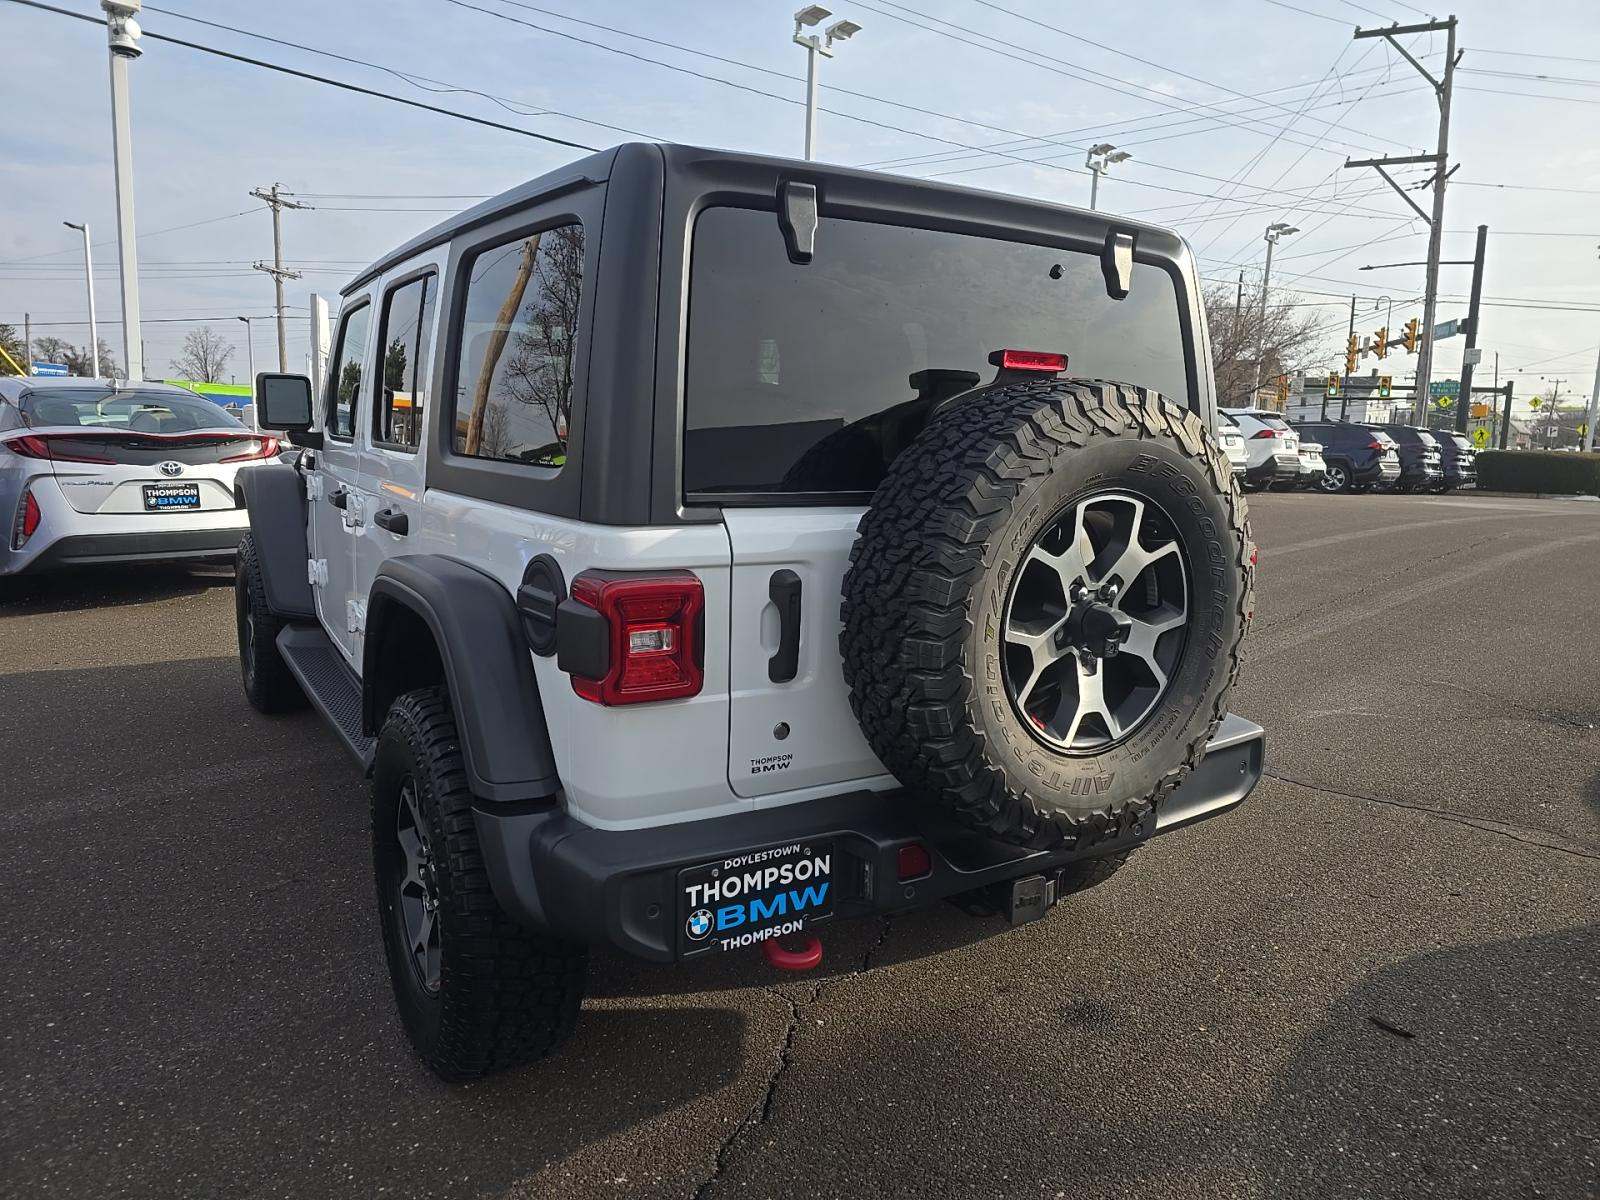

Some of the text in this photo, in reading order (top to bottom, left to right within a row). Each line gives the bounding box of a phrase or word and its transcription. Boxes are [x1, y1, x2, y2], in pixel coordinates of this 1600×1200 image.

[146, 489, 197, 497] THOMPSON
[158, 496, 197, 505] BMW
[750, 753, 793, 766] THOMPSON
[751, 761, 791, 774] BMW
[724, 844, 801, 870] DOYLESTOWN
[685, 854, 831, 908] THOMPSON
[716, 882, 830, 931] BMW
[720, 919, 804, 952] THOMPSON
